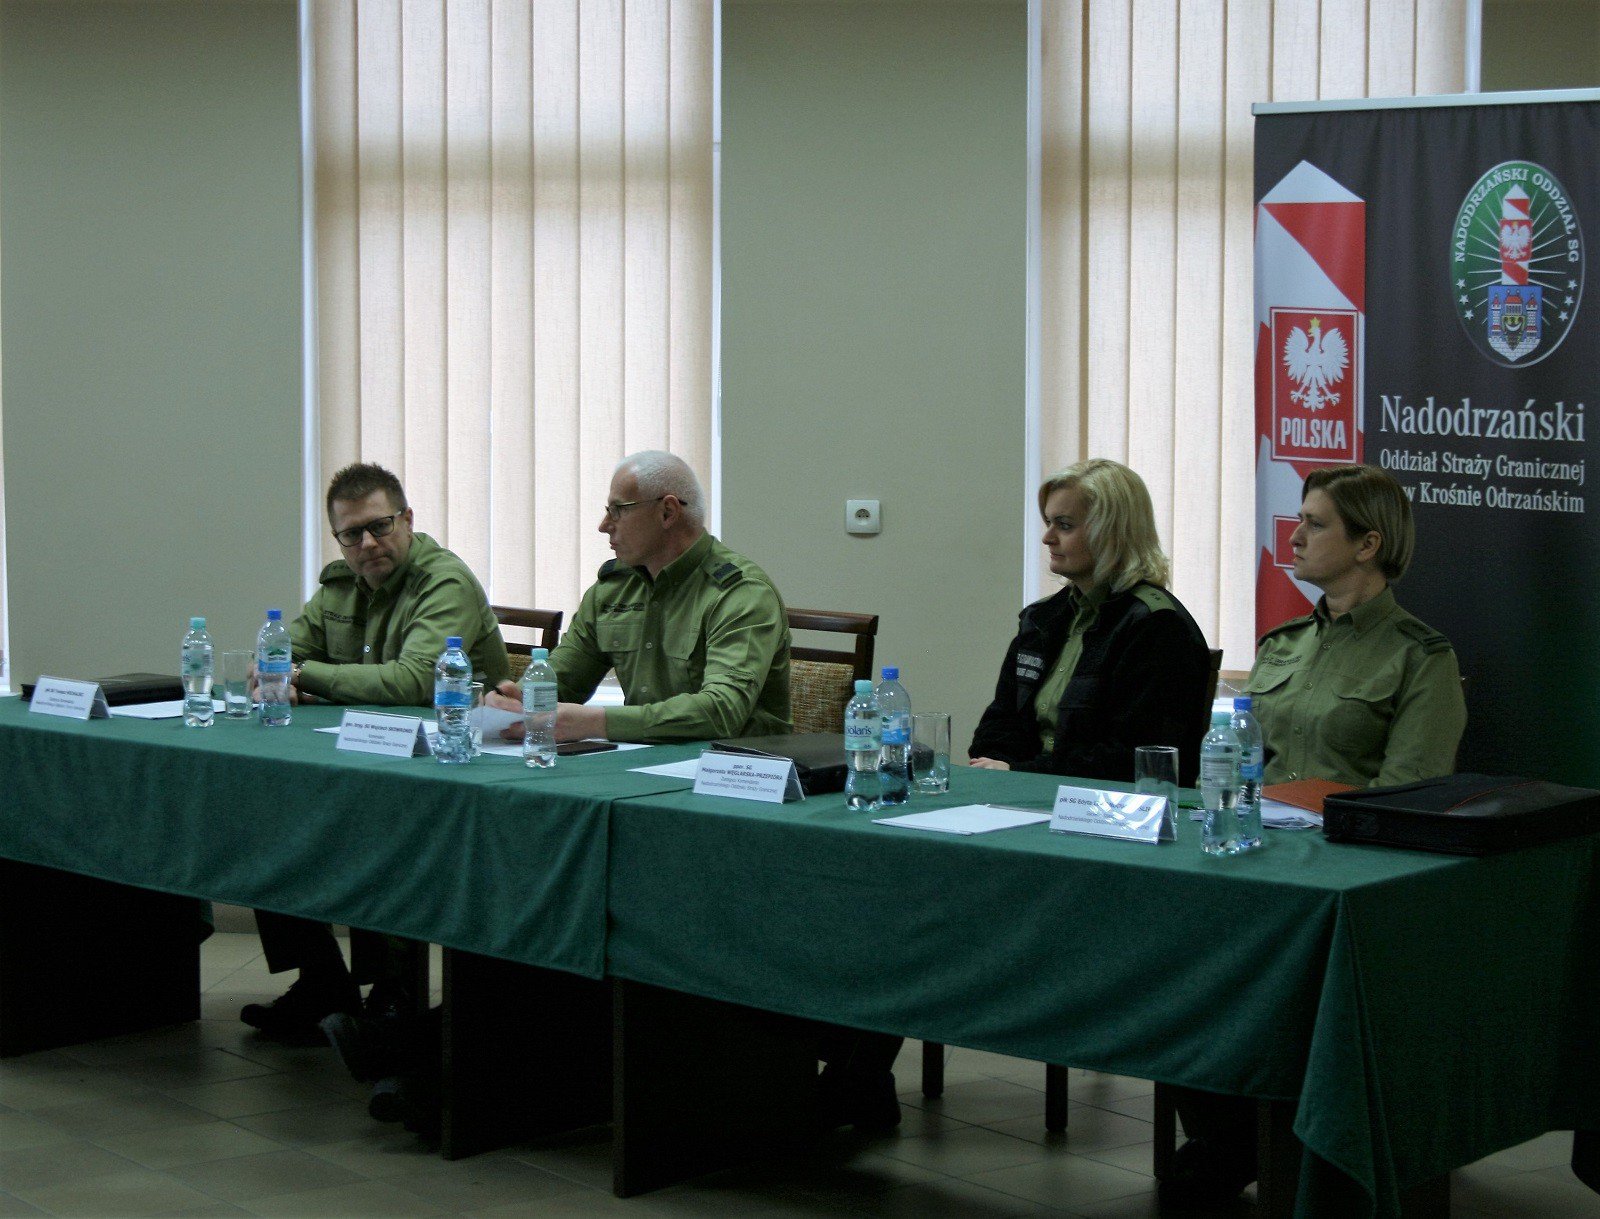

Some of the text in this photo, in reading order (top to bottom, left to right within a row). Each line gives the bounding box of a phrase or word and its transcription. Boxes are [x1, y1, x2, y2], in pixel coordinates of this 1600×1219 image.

[1455, 167, 1580, 263] NADODRZAŃSKI ODDZIAŁ SG
[1281, 417, 1347, 449] POLSKA
[1380, 395, 1585, 442] Nadodrzański
[1380, 449, 1586, 486] Oddział Straży Granicznej
[1403, 482, 1585, 513] w Krośnie Odrzańskim
